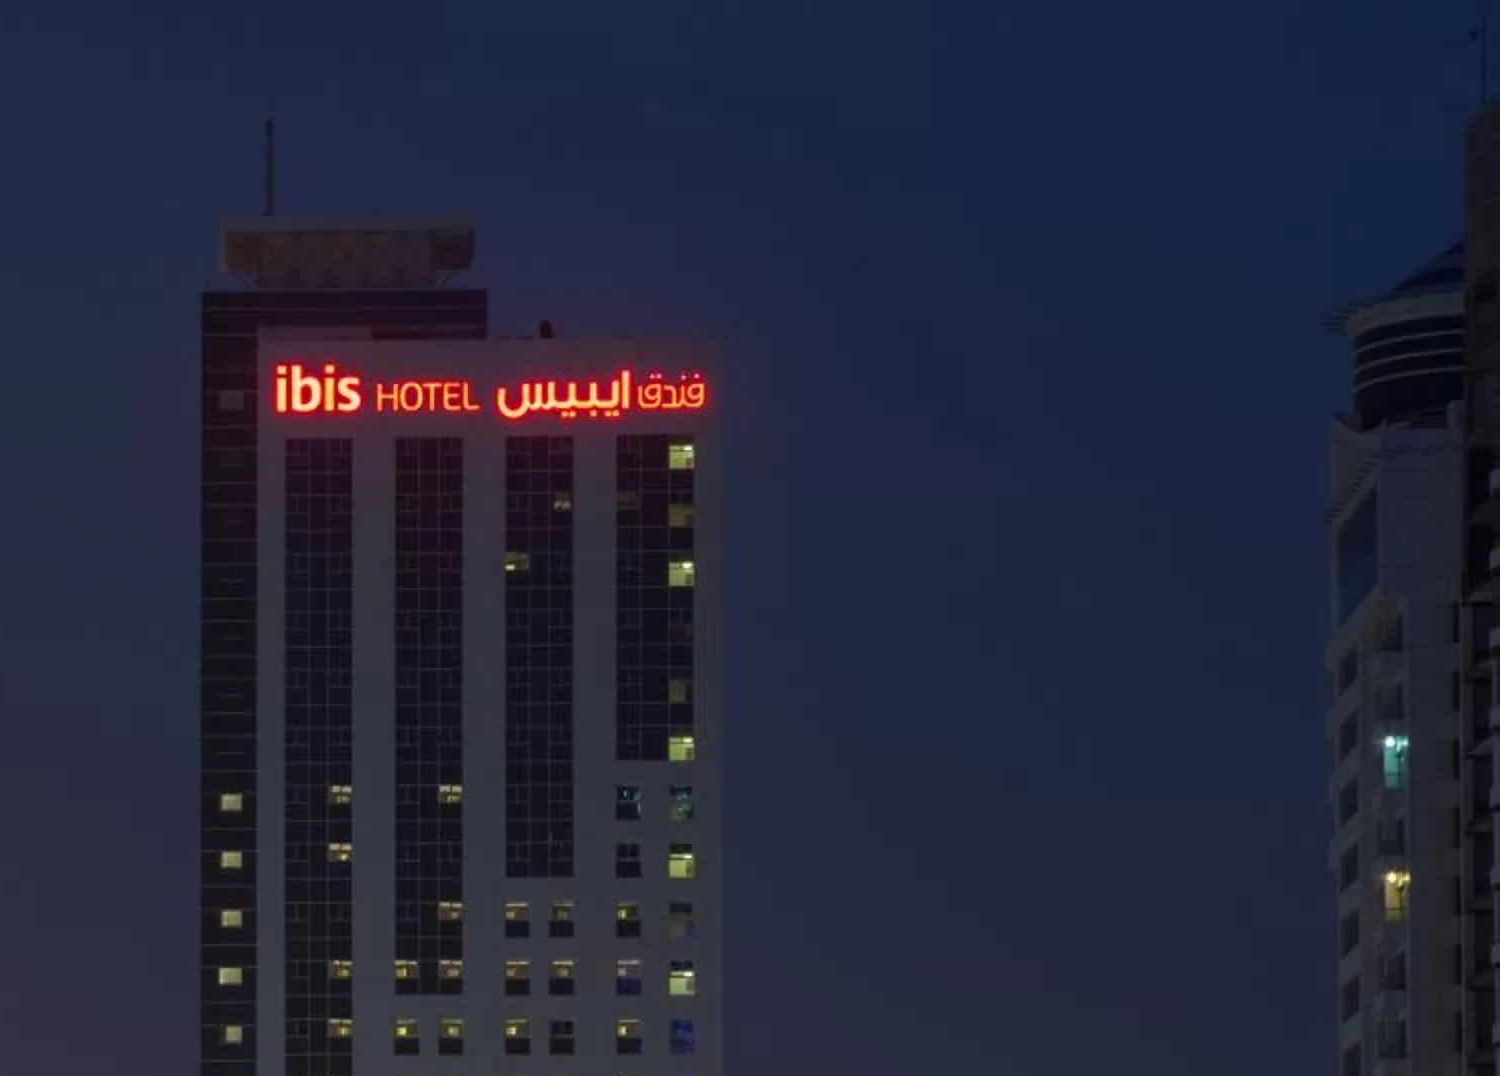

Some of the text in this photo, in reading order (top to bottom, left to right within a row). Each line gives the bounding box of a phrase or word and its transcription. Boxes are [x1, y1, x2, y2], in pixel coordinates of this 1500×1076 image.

[275, 364, 480, 412] ibis HOTEL
[497, 370, 706, 417] فندق ايبيس
